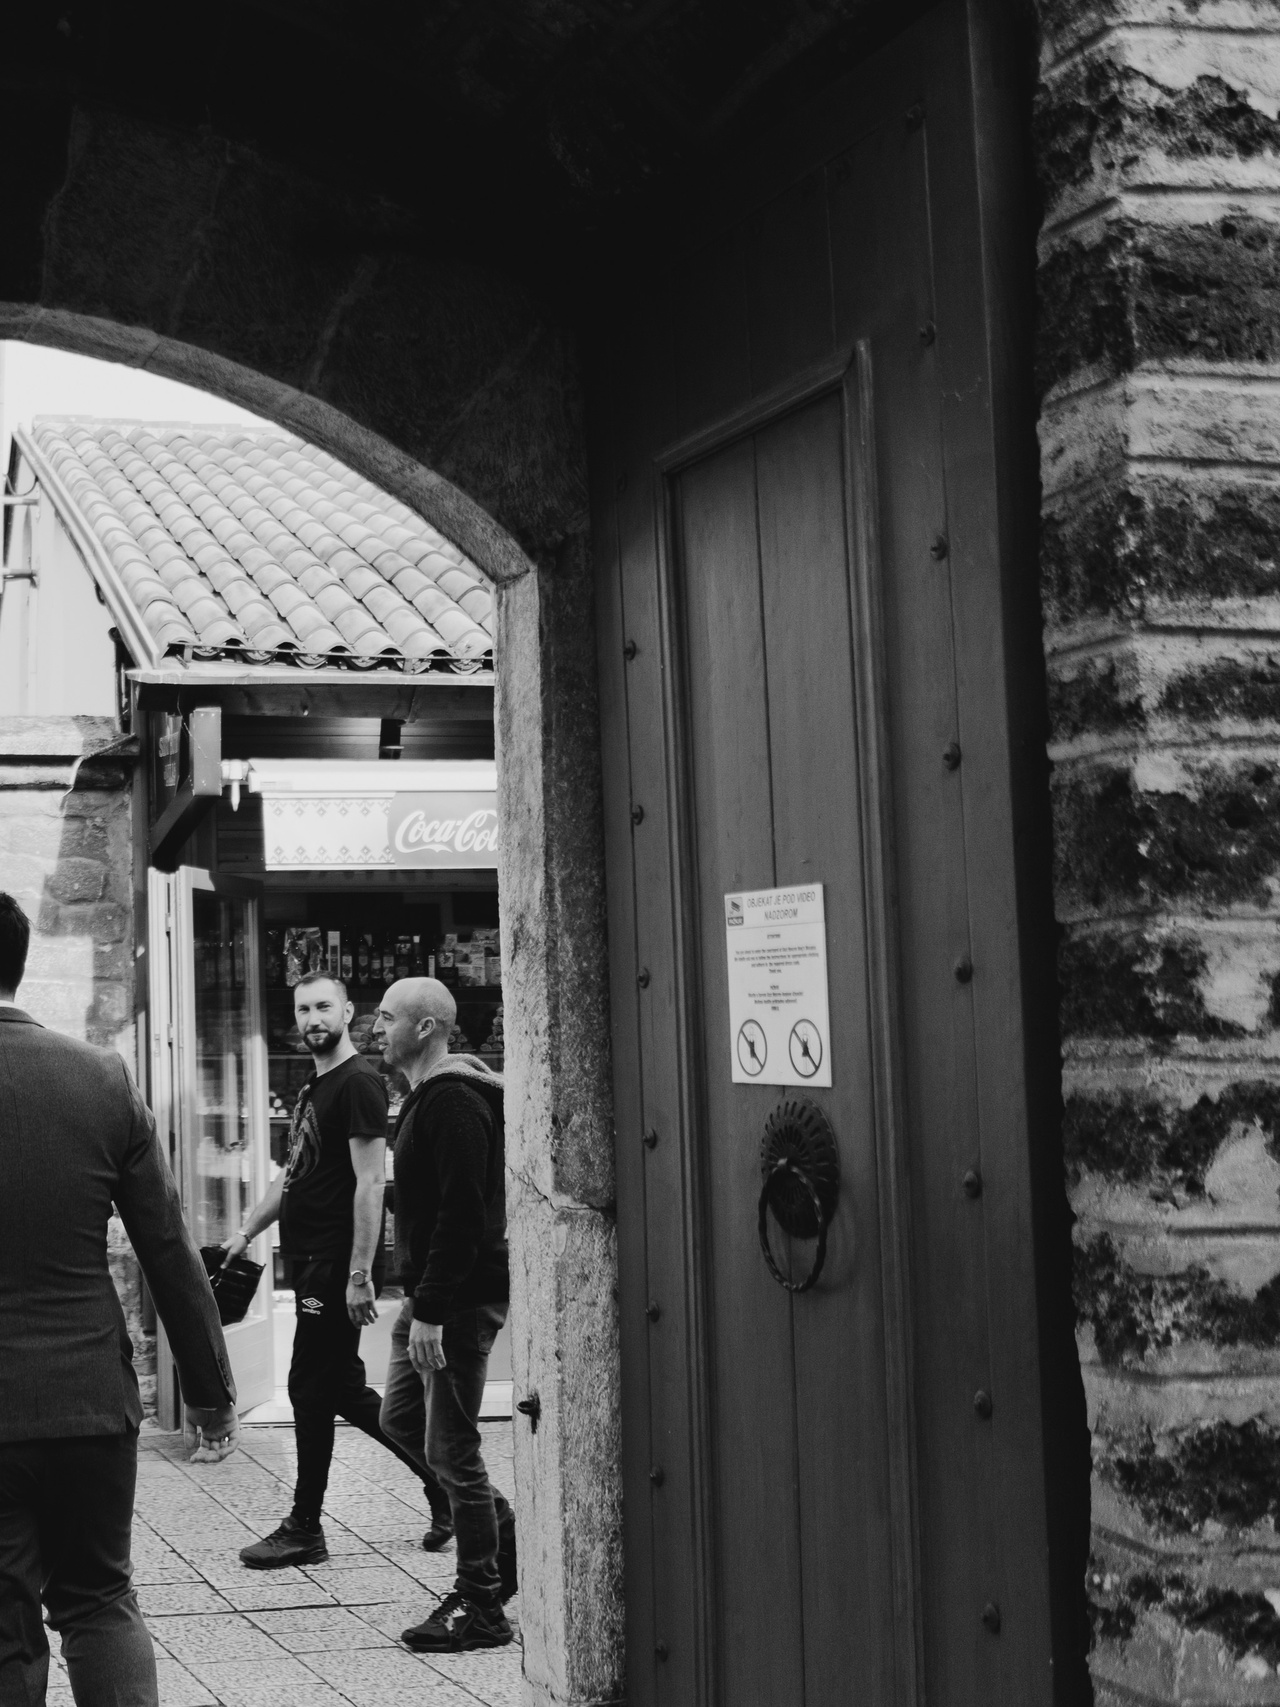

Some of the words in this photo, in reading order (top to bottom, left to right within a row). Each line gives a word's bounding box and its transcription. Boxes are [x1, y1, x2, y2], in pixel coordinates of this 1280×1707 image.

[395, 809, 498, 853] Coca-Col
[747, 897, 773, 908] OBJEKAT
[774, 895, 781, 906] JE
[782, 893, 795, 904] POD
[797, 891, 816, 903] VIDEO
[764, 909, 798, 920] NADZOROM
